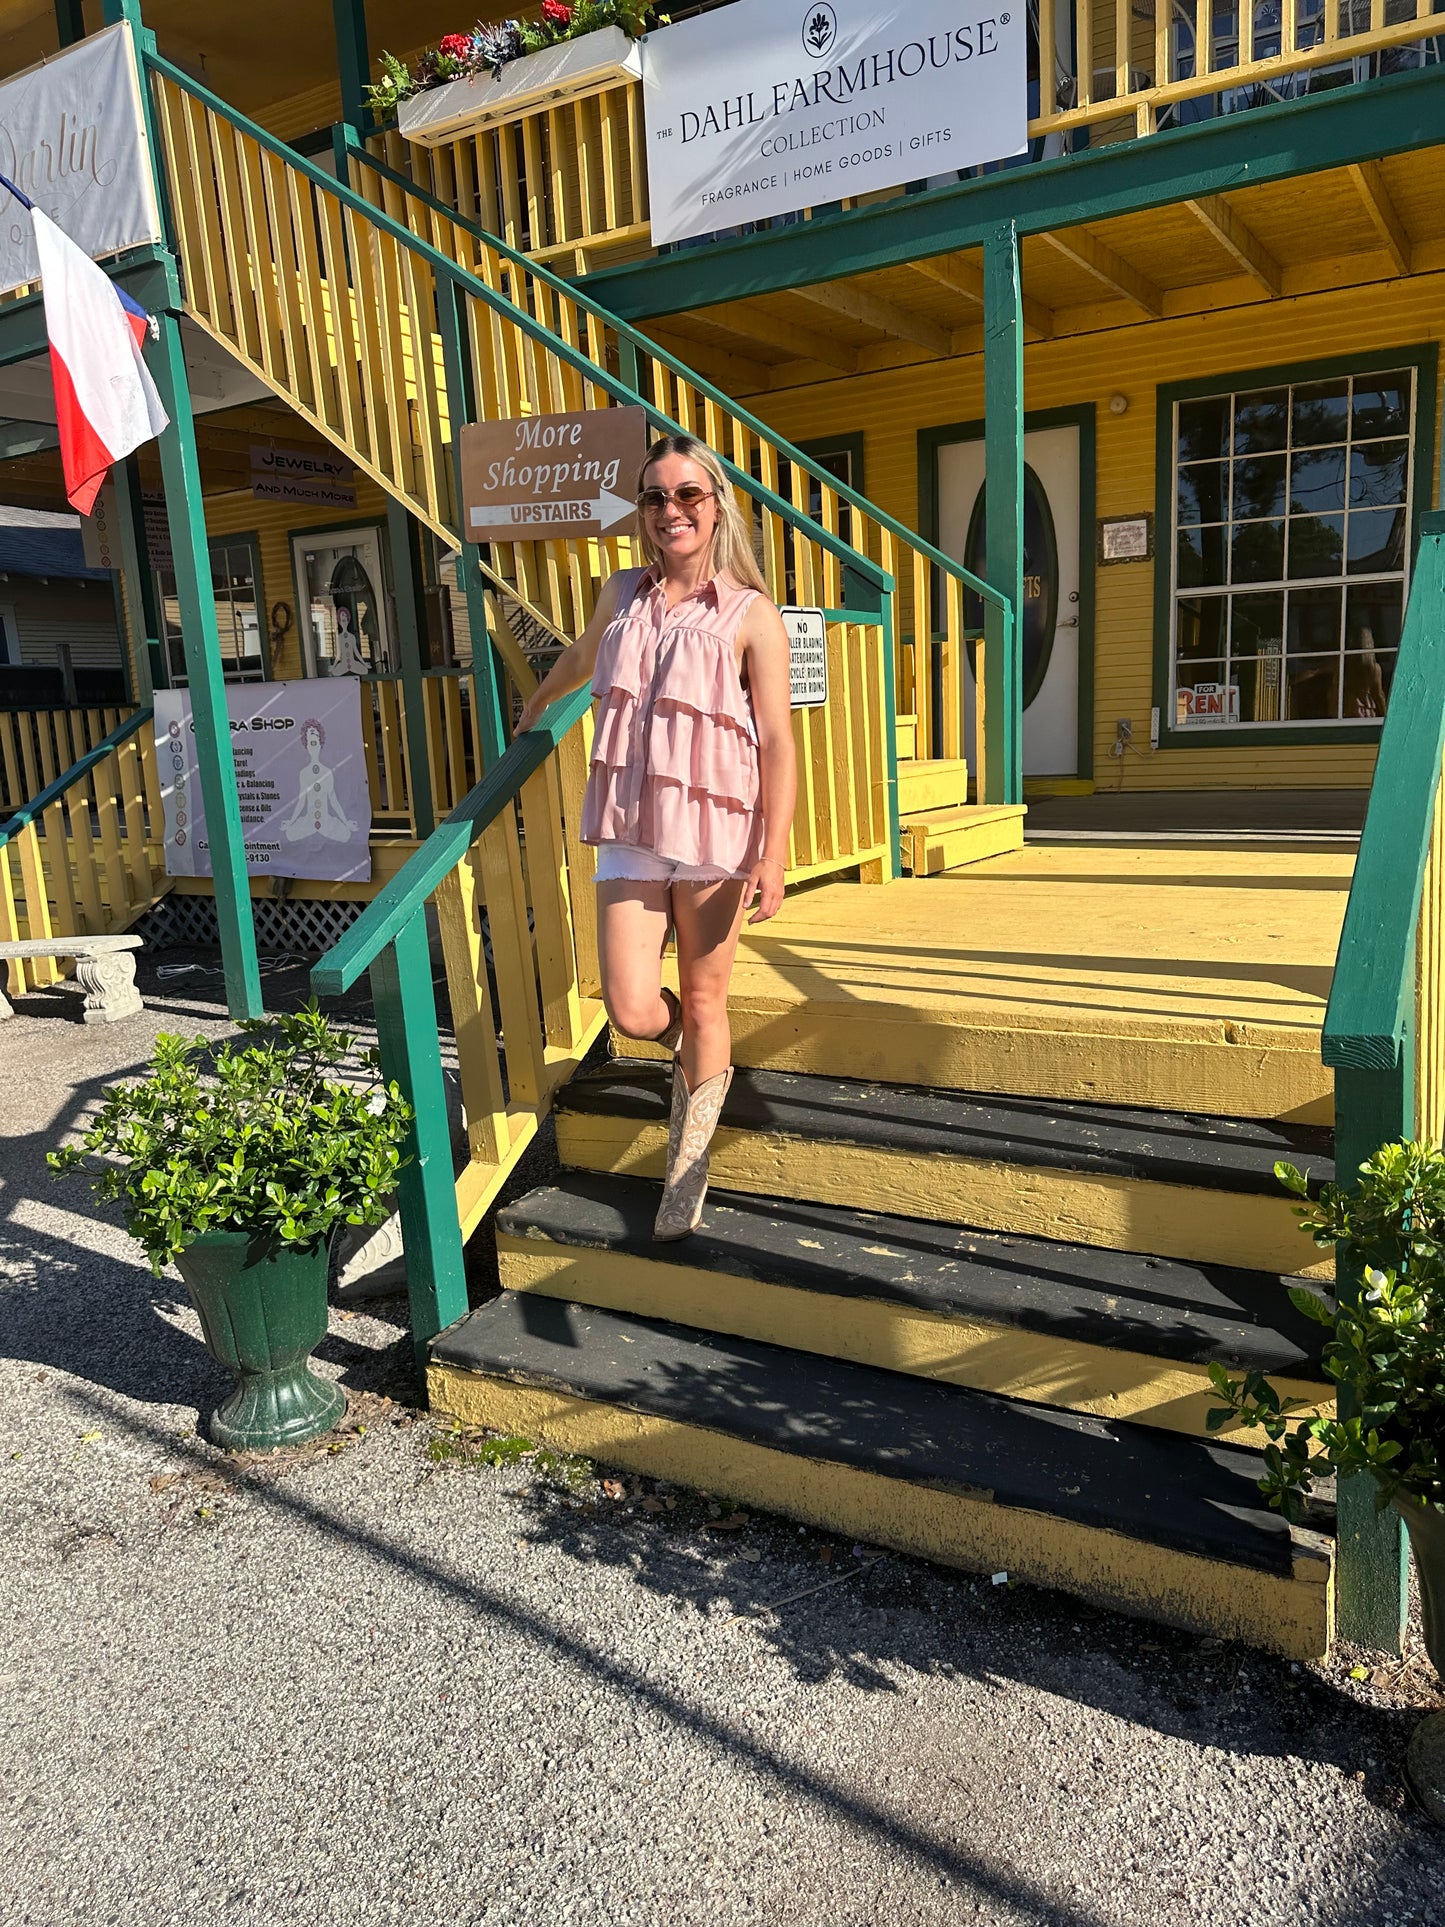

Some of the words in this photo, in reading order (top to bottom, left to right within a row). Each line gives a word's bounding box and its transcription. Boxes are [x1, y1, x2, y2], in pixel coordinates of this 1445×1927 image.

[656, 128, 673, 140] THE
[680, 92, 766, 144] DAHL
[760, 107, 886, 158] COLLECTION
[701, 175, 778, 206] FRAGRANCE
[793, 160, 833, 182] HOME
[838, 144, 893, 169] GOODS
[909, 128, 952, 150] GIFTS
[515, 418, 583, 451] More
[262, 452, 344, 475] JEWELRY
[482, 453, 621, 495] Shopping
[256, 482, 281, 494] AND
[283, 485, 319, 497] MUCH
[321, 490, 354, 503] MORE
[511, 501, 592, 523] UPSTAIRS
[797, 622, 808, 633] NO
[789, 637, 801, 649] LLER
[790, 652, 823, 664] ATEBOARDING
[790, 667, 805, 679] CYCLE
[807, 666, 824, 678] RIDING
[808, 681, 825, 693] RIDING
[1178, 688, 1237, 714] RENT
[251, 717, 295, 731] SHOP
[247, 779, 275, 789] Balancing
[261, 791, 280, 801] Stones
[244, 842, 280, 851] ointment
